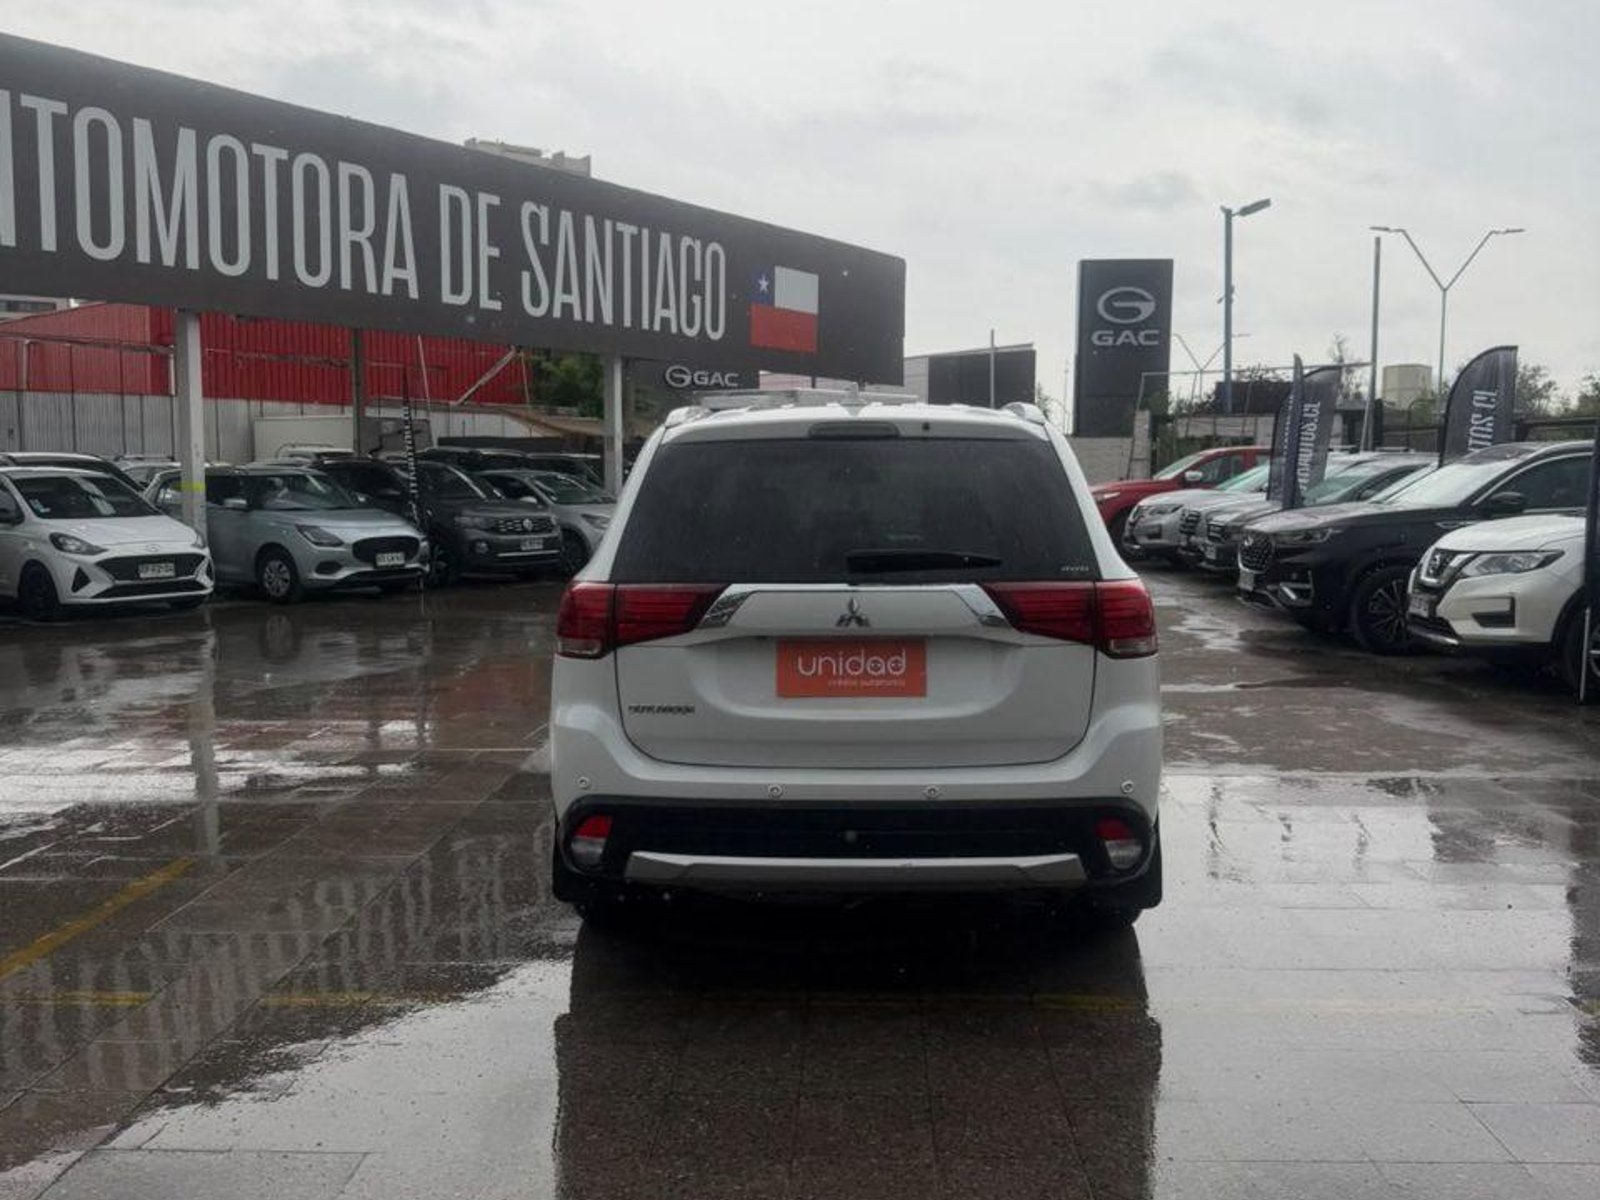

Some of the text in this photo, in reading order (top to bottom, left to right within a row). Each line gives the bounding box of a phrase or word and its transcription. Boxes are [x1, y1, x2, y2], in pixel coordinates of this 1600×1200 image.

[0, 89, 725, 339] TOMOTORA DE SANTIAGO
[1091, 330, 1159, 345] GAC
[693, 370, 739, 387] GAC
[797, 648, 907, 676] unidad
